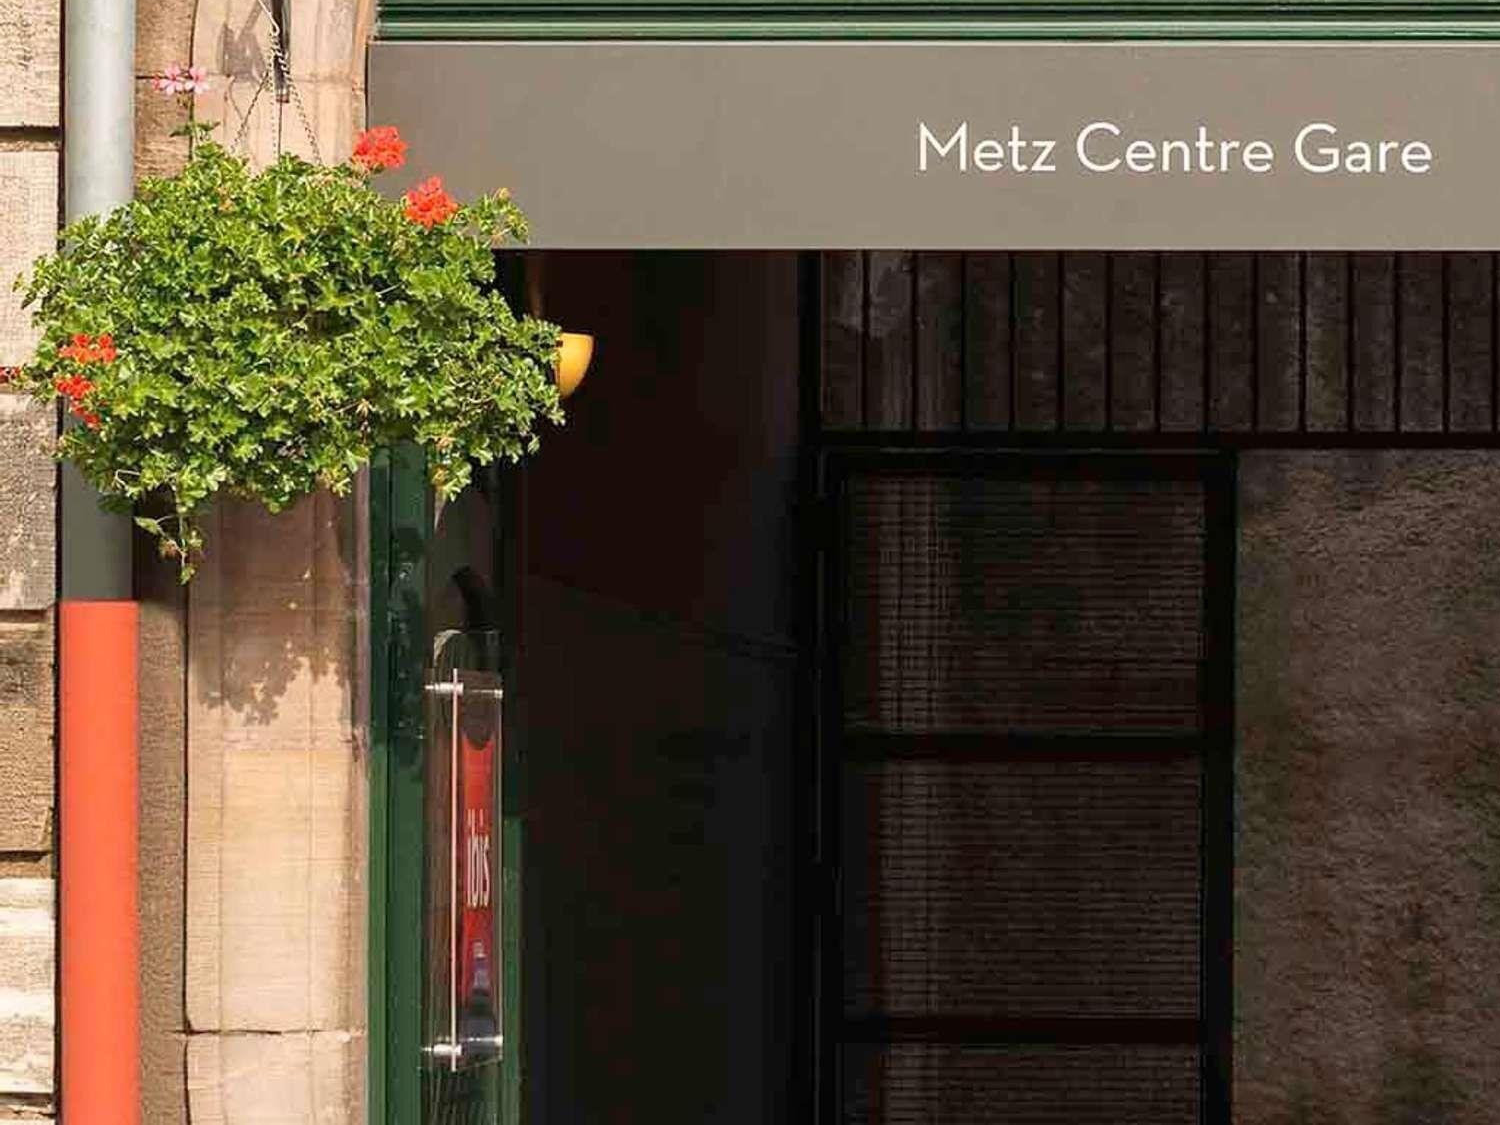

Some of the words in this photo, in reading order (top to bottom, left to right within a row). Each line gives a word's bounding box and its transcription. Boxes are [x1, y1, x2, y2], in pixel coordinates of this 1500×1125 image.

[917, 122, 1057, 173] Metz
[1076, 121, 1274, 174] Centre
[1294, 122, 1433, 174] Gare
[467, 808, 491, 909] ibis
